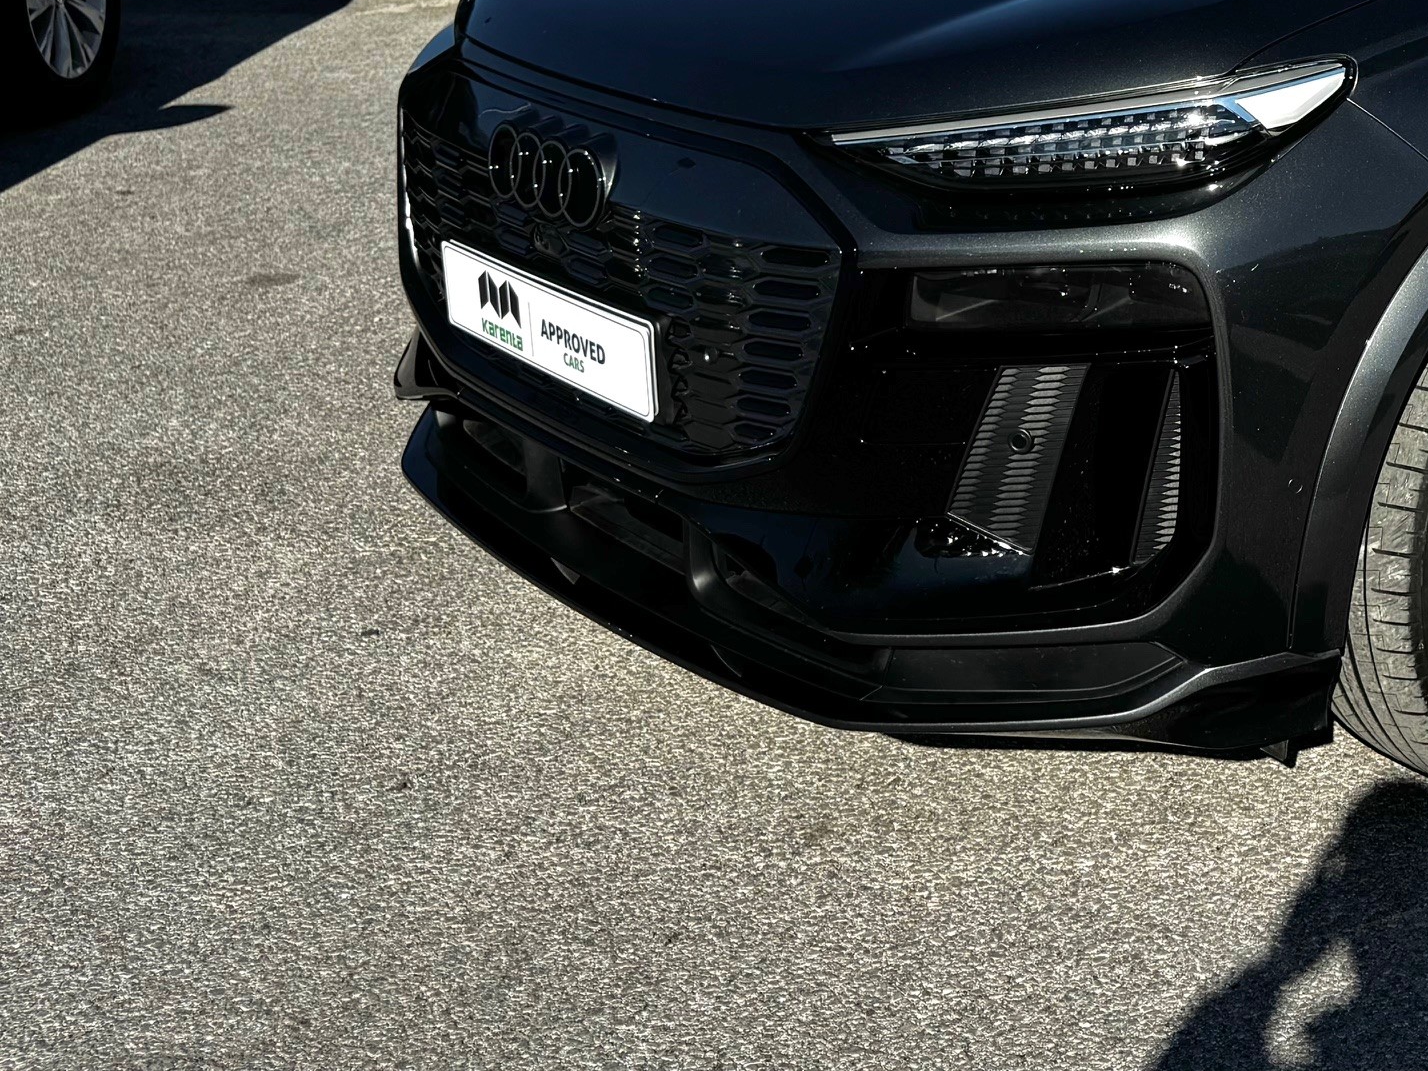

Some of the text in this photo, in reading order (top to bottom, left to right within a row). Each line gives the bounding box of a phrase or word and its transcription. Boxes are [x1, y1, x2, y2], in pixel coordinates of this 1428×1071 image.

[481, 317, 524, 351] karenta
[541, 318, 606, 364] APPROVED
[563, 352, 585, 373] CARS
